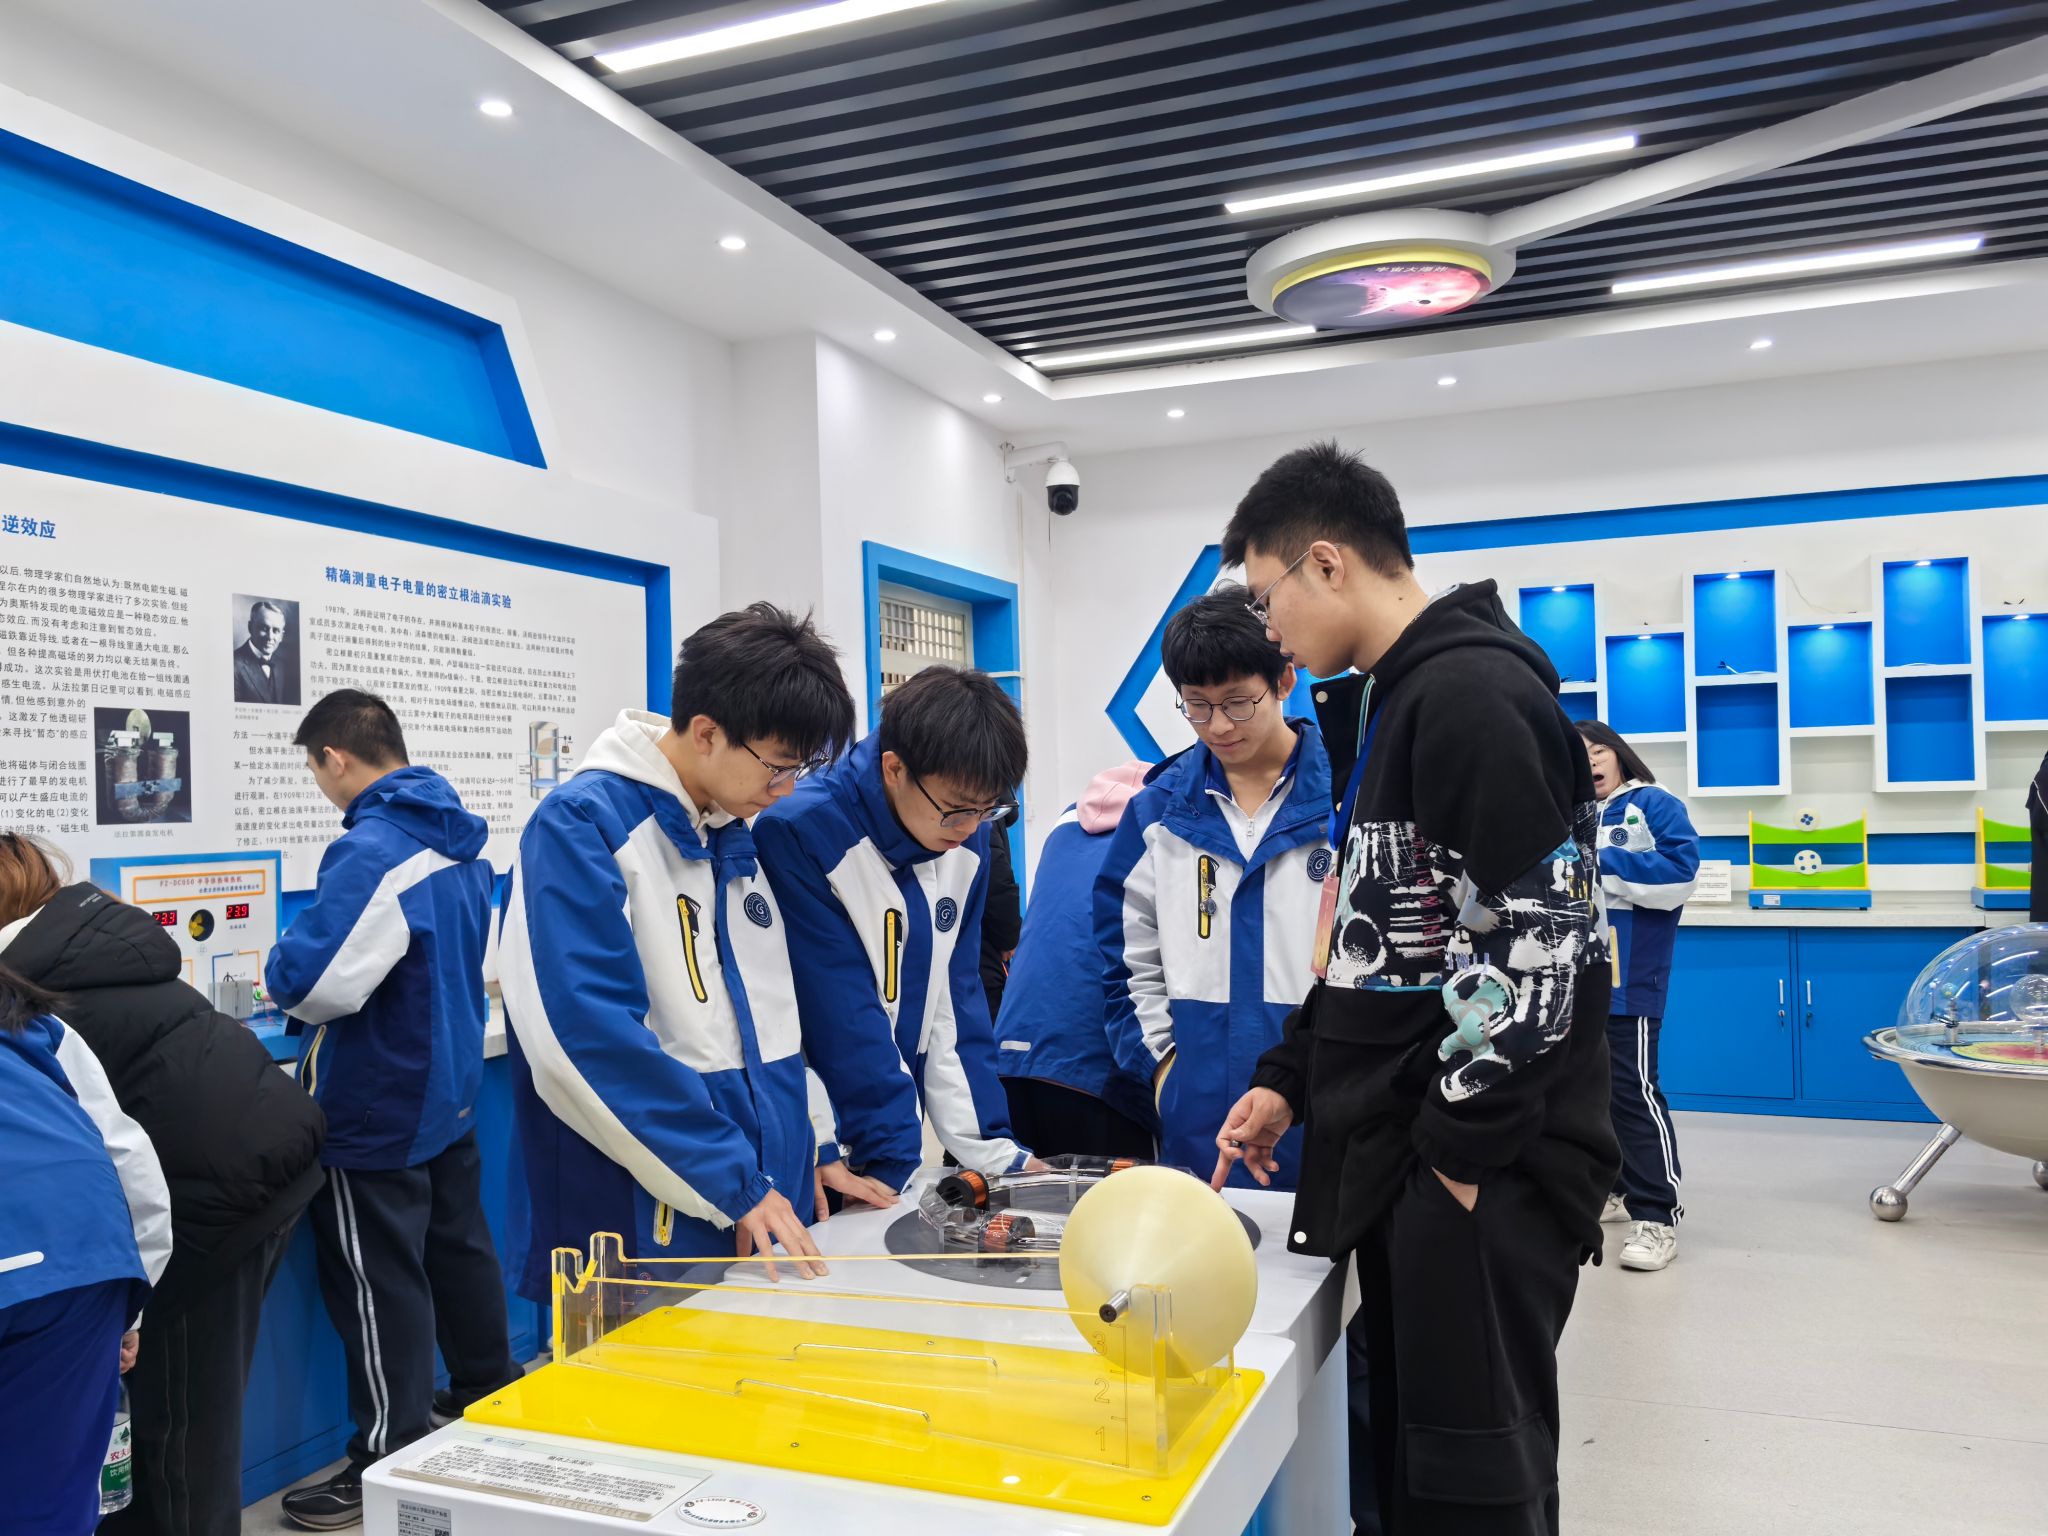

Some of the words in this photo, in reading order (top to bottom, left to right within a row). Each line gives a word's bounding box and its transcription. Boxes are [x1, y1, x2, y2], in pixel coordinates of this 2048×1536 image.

[1, 513, 56, 539] 逆效应
[325, 566, 512, 609] 精确测量电子电量的密立根油滴实验
